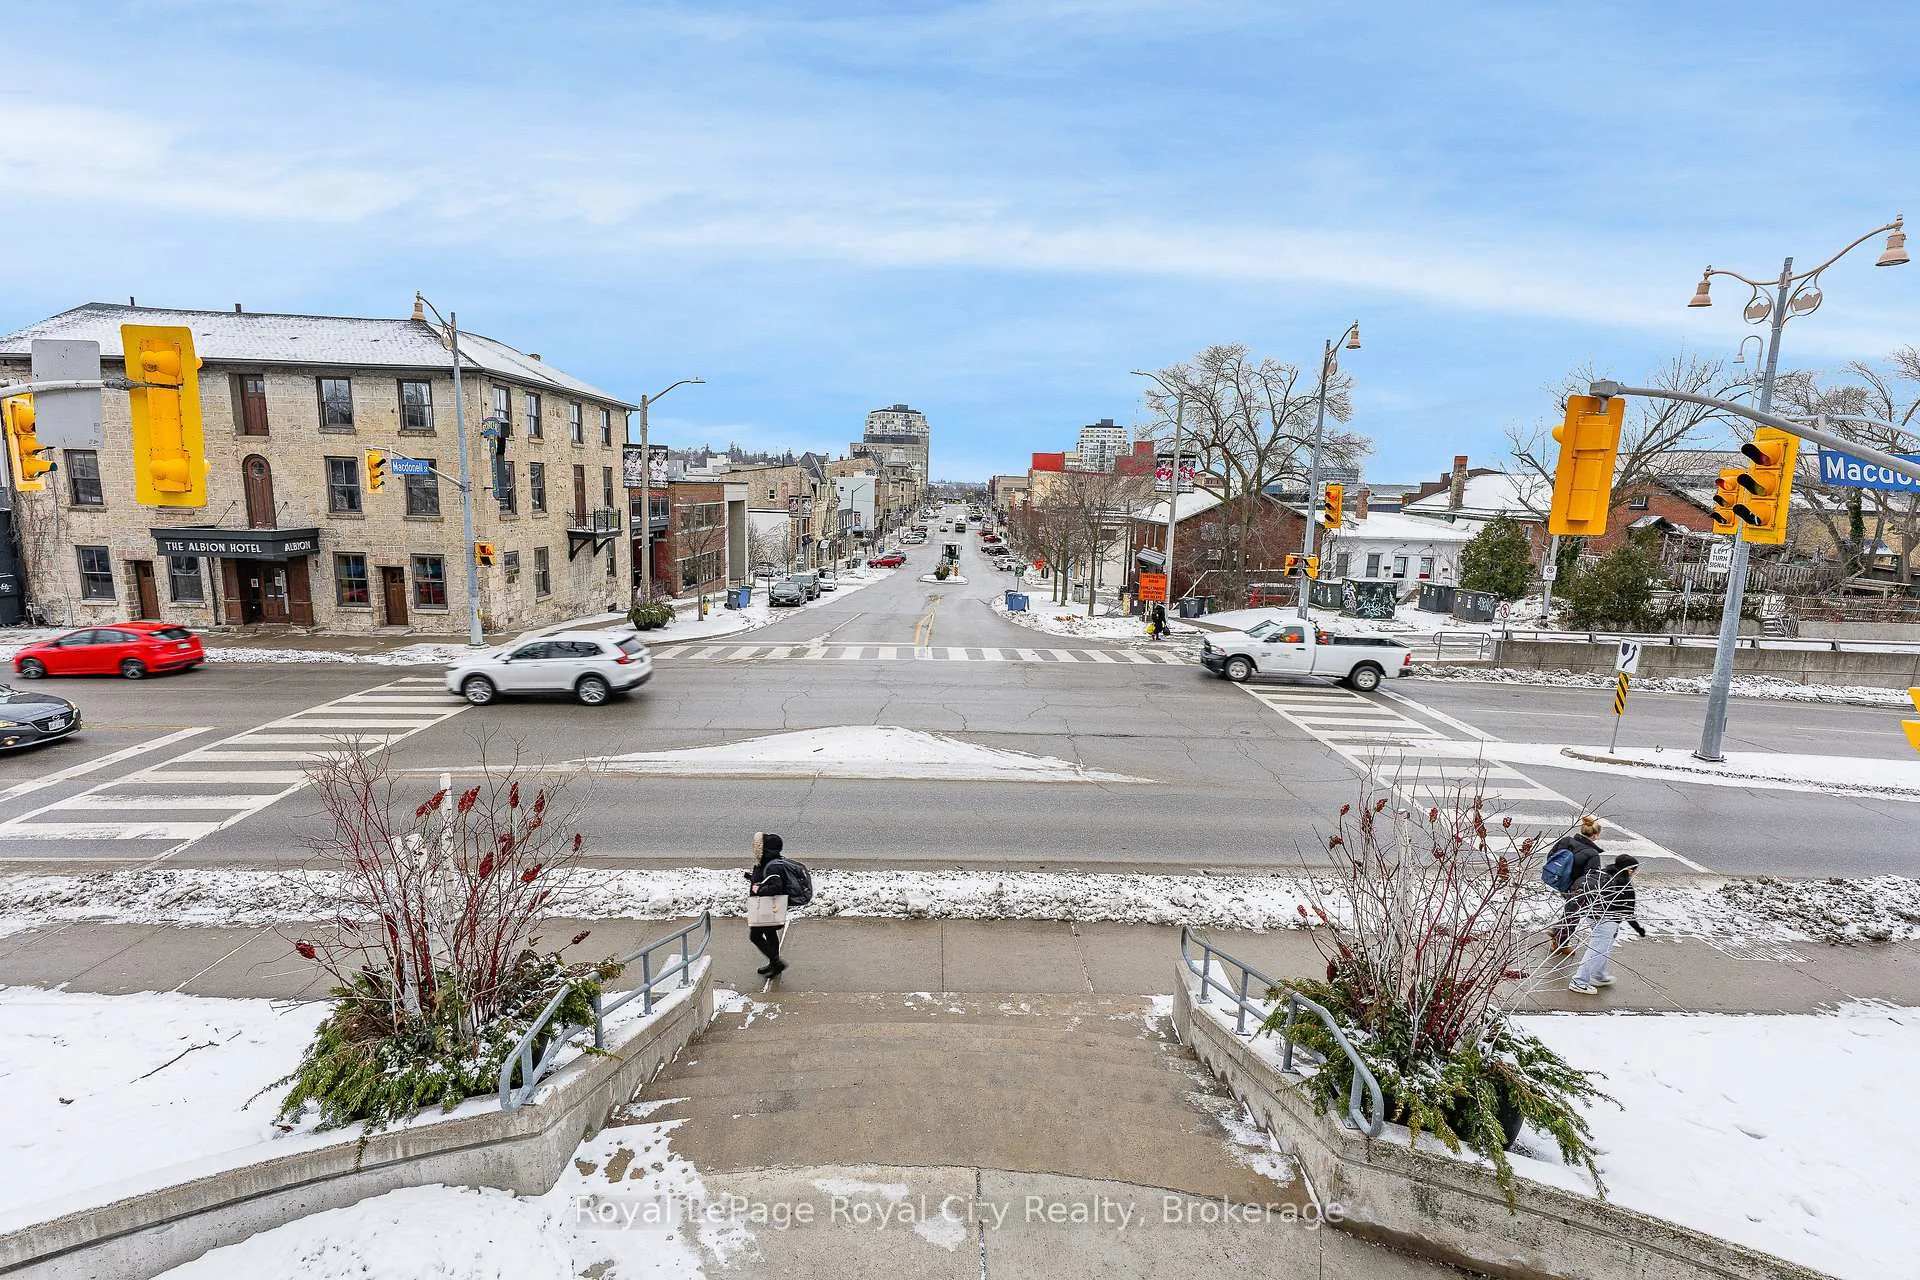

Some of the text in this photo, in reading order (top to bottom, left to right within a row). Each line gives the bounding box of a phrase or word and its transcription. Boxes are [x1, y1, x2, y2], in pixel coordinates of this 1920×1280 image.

[1826, 456, 1920, 486] Macdo
[165, 541, 262, 553] THE ALBION HOTEL
[284, 541, 311, 552] ALBION
